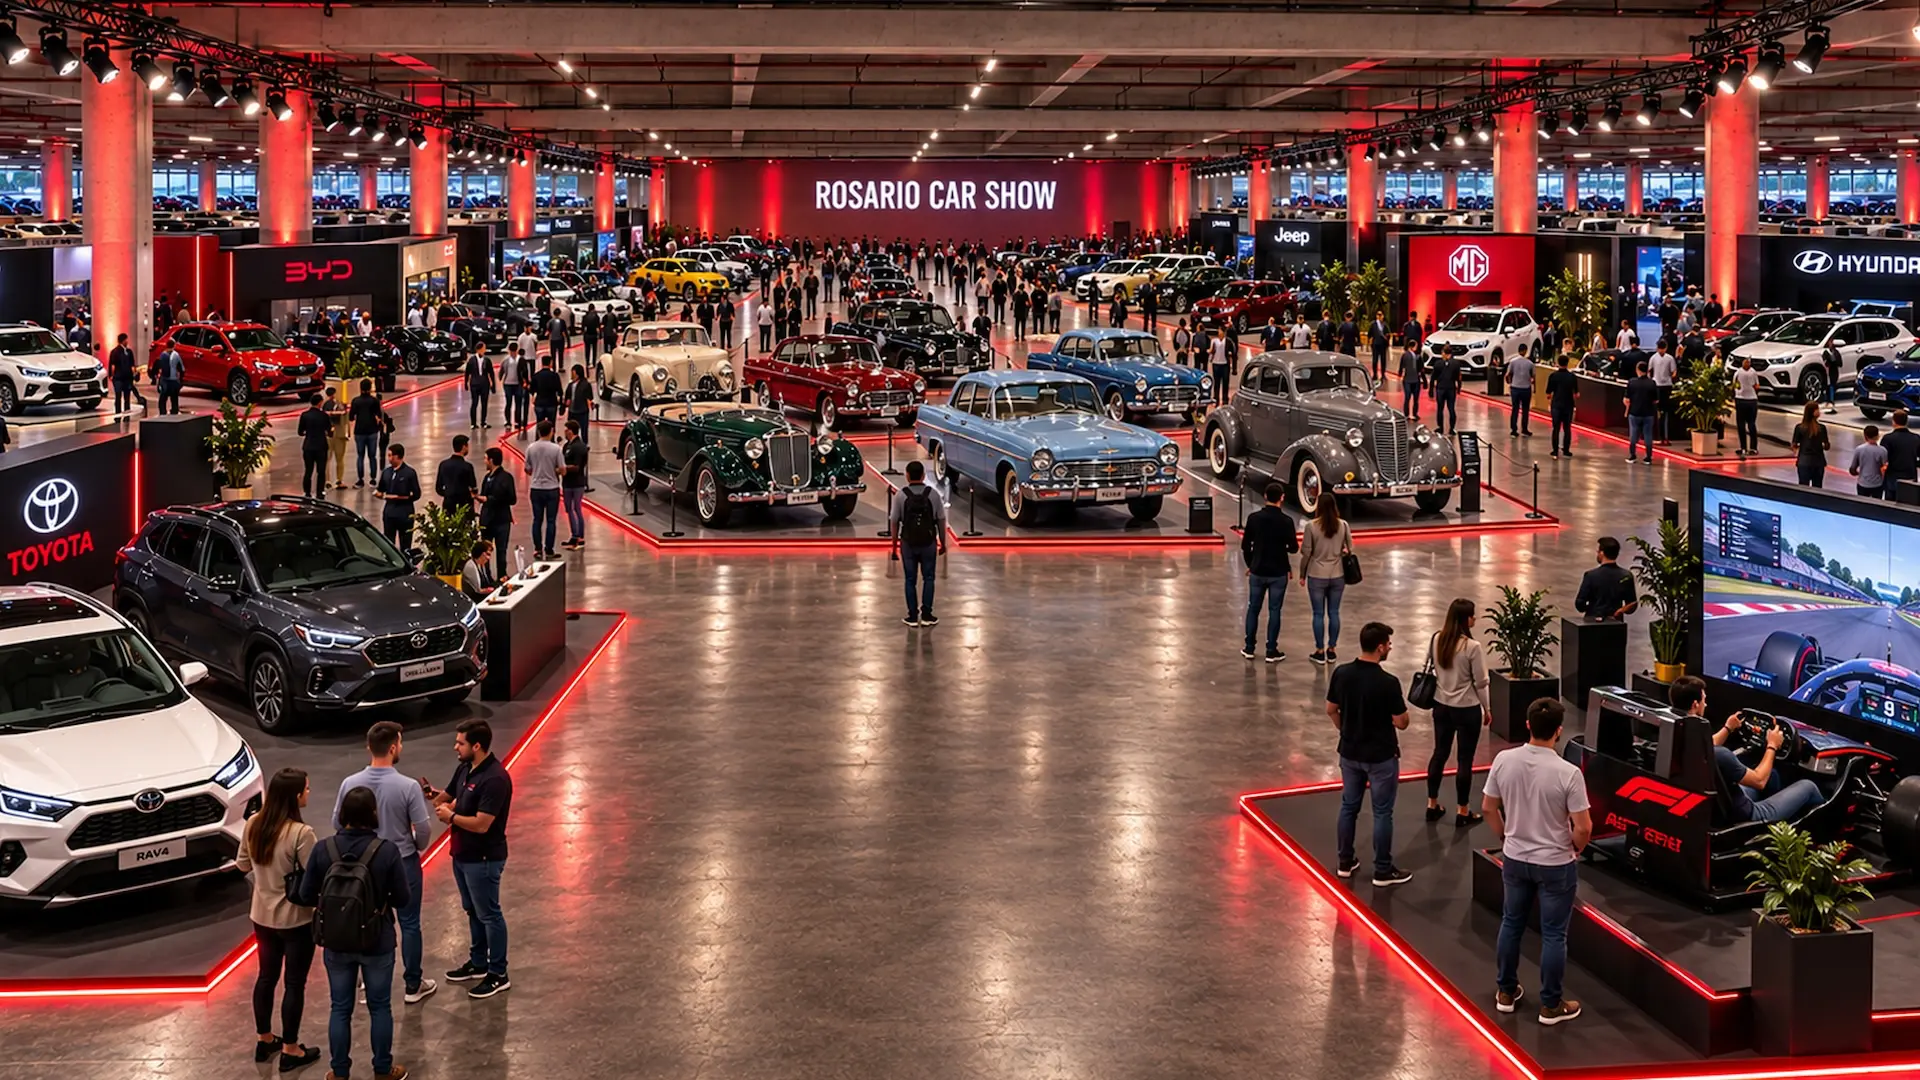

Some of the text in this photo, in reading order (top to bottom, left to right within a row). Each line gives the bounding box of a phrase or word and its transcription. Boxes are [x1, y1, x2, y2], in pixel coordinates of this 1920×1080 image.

[815, 180, 1058, 210] ROSARIO CAR SHOW
[1273, 226, 1310, 247] Jeep
[285, 259, 354, 283] BYD
[1452, 248, 1486, 283] MG
[7, 530, 95, 576] TOYOTA
[1883, 700, 1895, 718] 9
[1614, 775, 1708, 817] F1
[136, 847, 170, 862] RAV4
